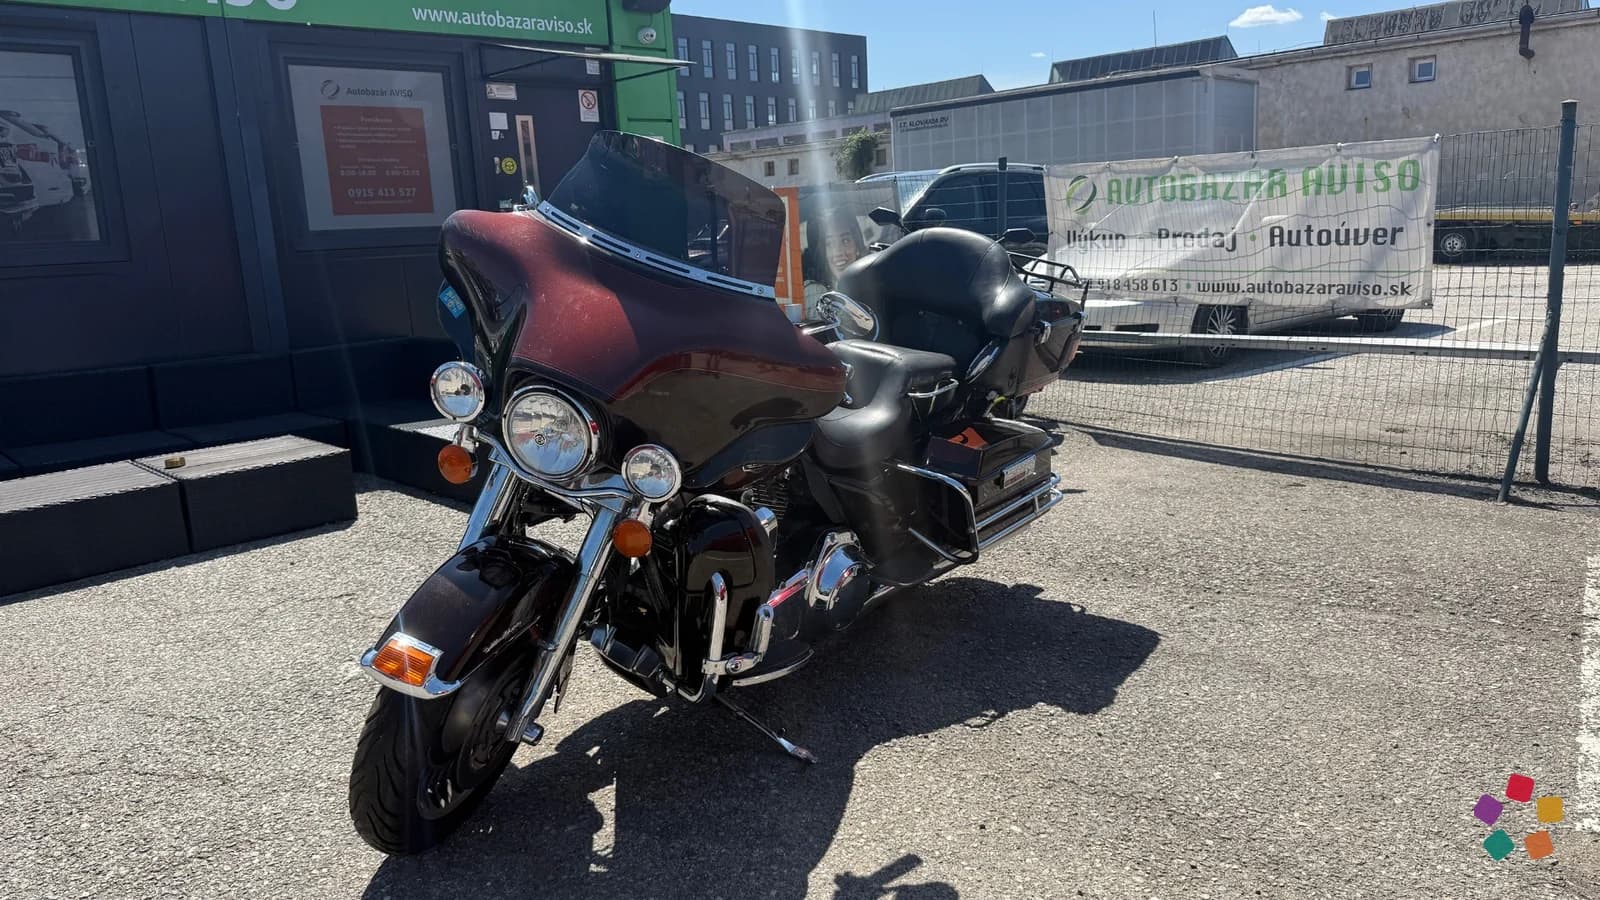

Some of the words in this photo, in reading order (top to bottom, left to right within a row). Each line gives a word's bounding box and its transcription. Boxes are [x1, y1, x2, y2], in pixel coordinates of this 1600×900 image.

[412, 7, 592, 35] www.autobazaraviso.sk
[389, 88, 413, 98] AVISO
[1302, 159, 1420, 197] AVISO
[1269, 221, 1404, 248] Autoúver
[1152, 279, 1178, 292] 613
[1197, 280, 1412, 297] www.autobazaraviso.sk
